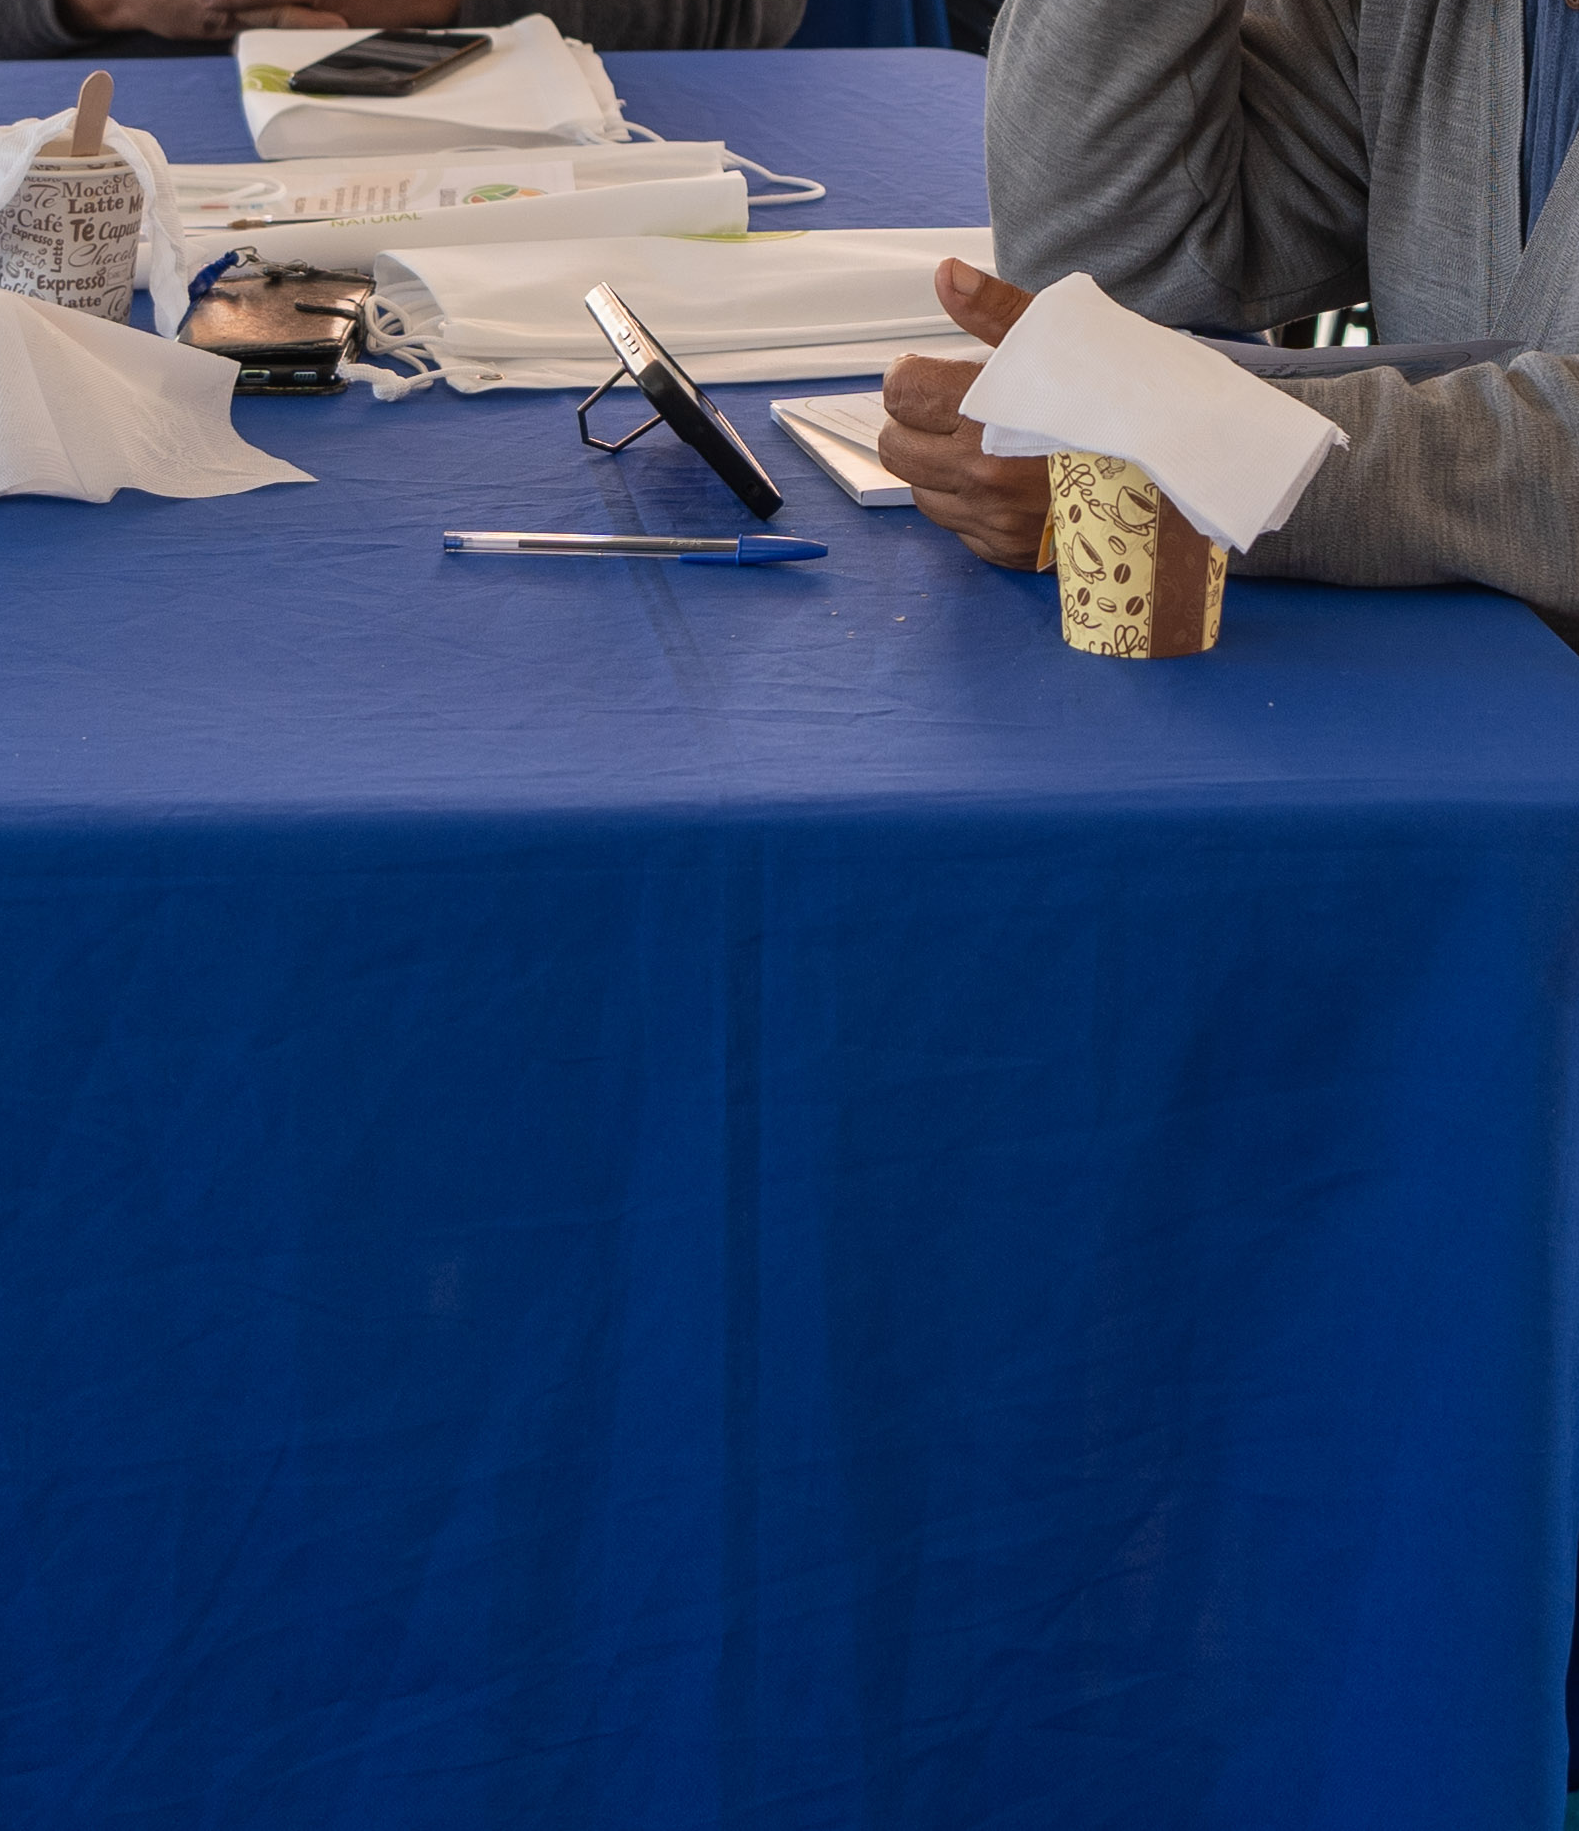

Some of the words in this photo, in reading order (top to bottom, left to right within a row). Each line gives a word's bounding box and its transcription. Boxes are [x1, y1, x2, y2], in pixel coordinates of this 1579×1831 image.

[61, 181, 119, 198] Mocca
[67, 196, 124, 215] Latte
[17, 208, 64, 233] Café
[69, 216, 95, 243] Té
[11, 224, 53, 246] Expresso
[0, 232, 46, 269] Expresso
[50, 238, 65, 273] Latte
[36, 274, 106, 297] Expresso
